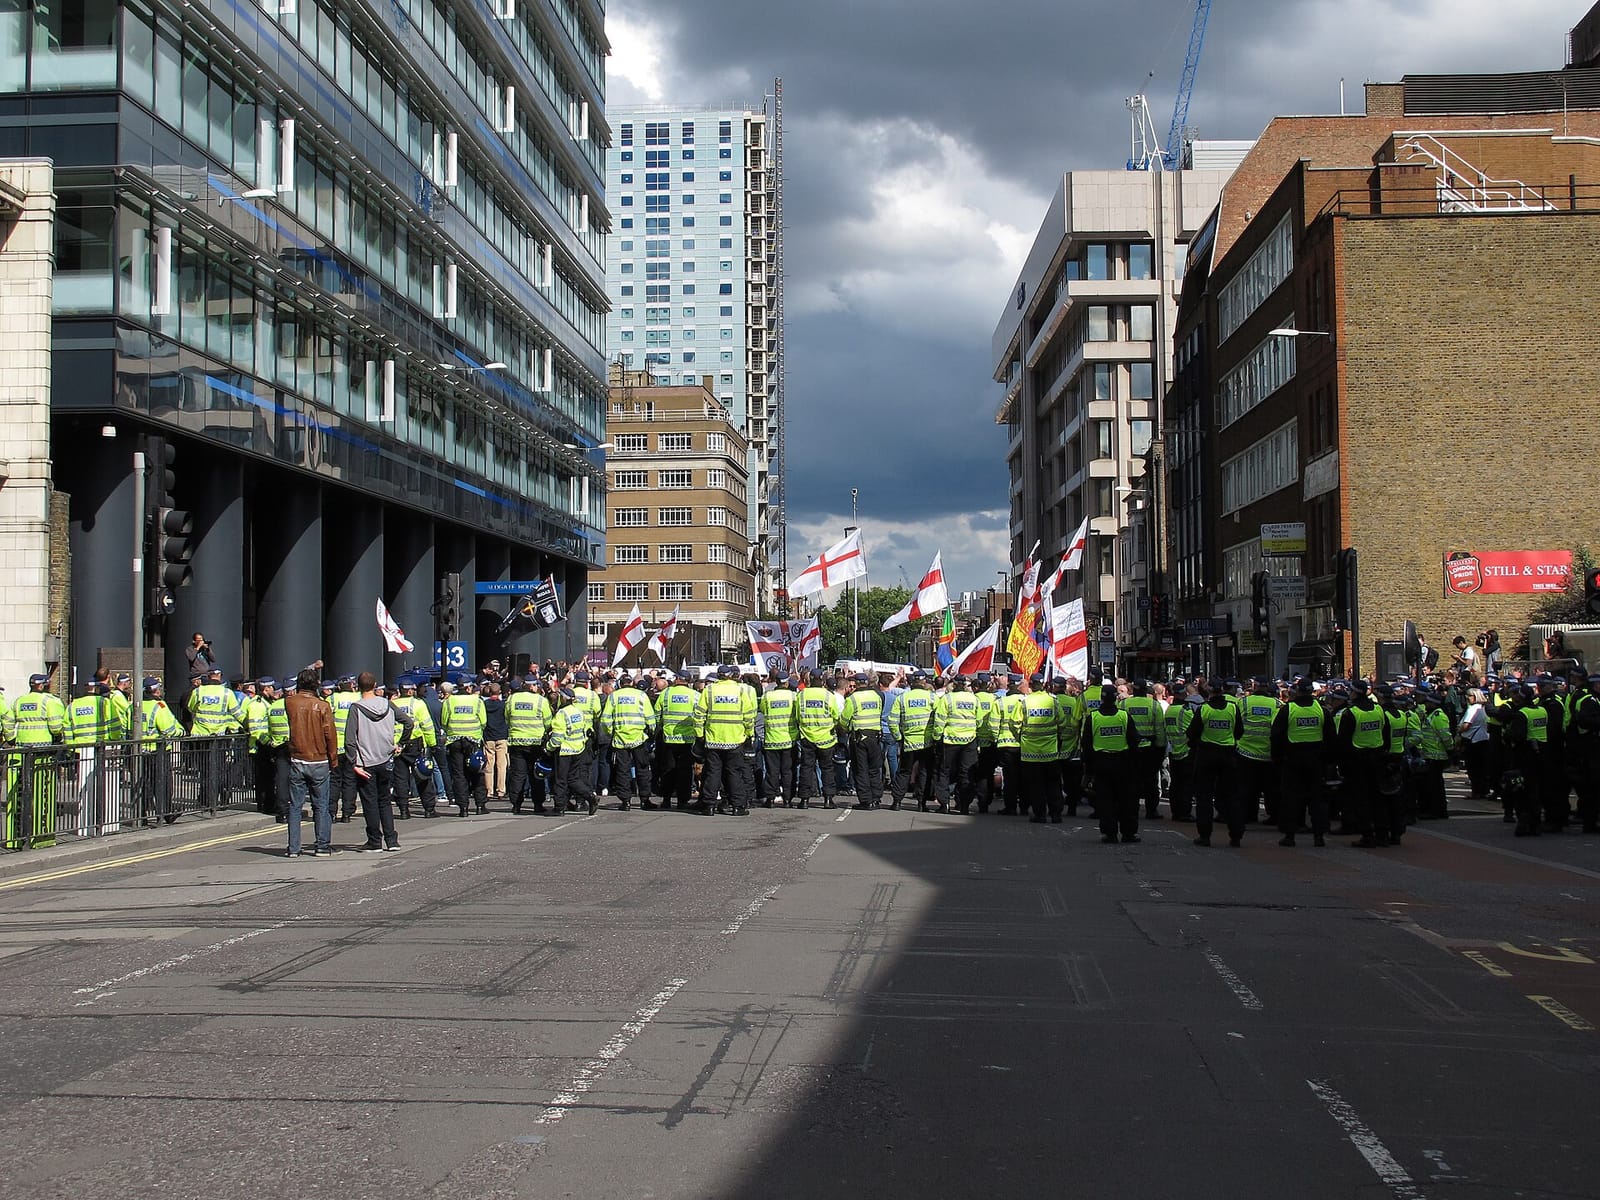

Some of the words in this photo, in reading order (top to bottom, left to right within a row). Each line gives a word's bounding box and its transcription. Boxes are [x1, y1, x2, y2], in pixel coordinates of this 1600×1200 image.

[1449, 565, 1476, 575] LONDON
[1484, 565, 1519, 576] STILL
[1522, 565, 1533, 576] &
[1536, 564, 1568, 576] STAR
[436, 646, 465, 667] 33
[1088, 700, 1102, 708] POL
[1029, 709, 1052, 717] POLICE
[1252, 707, 1271, 715] POLICE
[1210, 720, 1229, 729] POLICE
[1298, 718, 1319, 726] POLICE
[1361, 722, 1380, 731] POLICE
